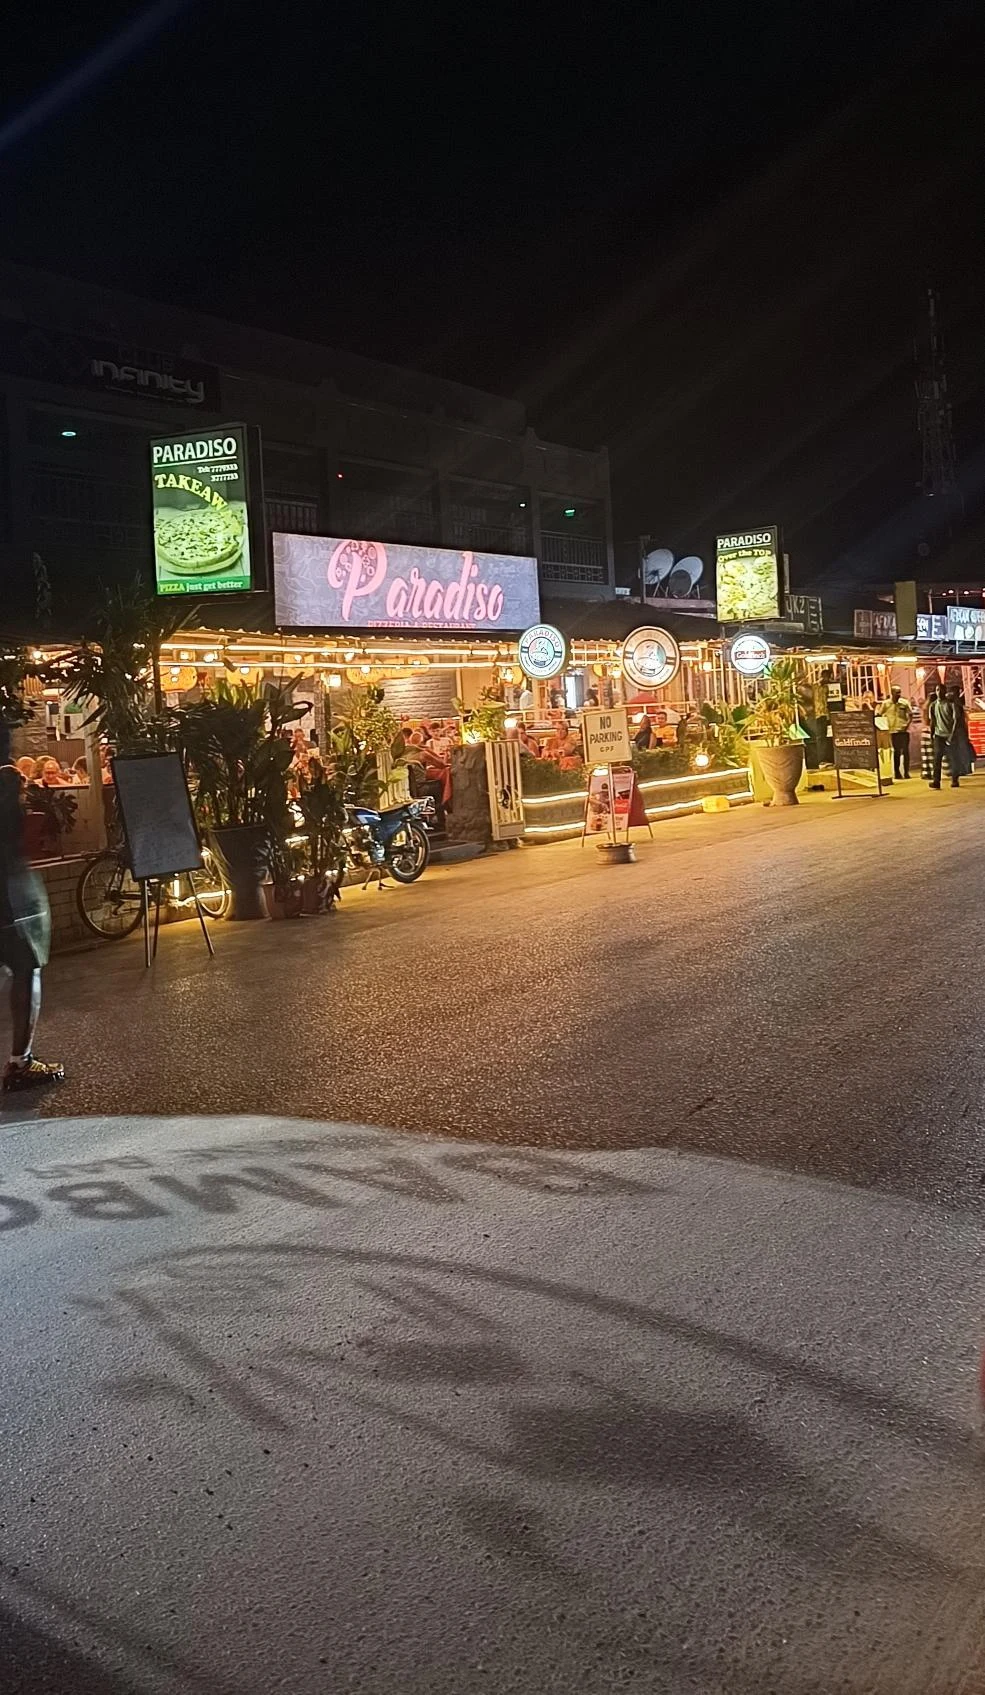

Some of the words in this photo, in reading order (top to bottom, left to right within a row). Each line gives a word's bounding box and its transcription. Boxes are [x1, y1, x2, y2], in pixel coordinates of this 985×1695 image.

[153, 437, 237, 464] PARADISO
[154, 473, 238, 524] TAKEAW
[717, 532, 771, 549] PARADISO
[159, 583, 185, 592] PIZZA
[186, 582, 202, 592] just
[203, 582, 216, 591] get
[217, 580, 243, 589] better
[327, 540, 504, 622] Paradiso
[599, 716, 611, 730] NO
[590, 731, 622, 744] PARKING
